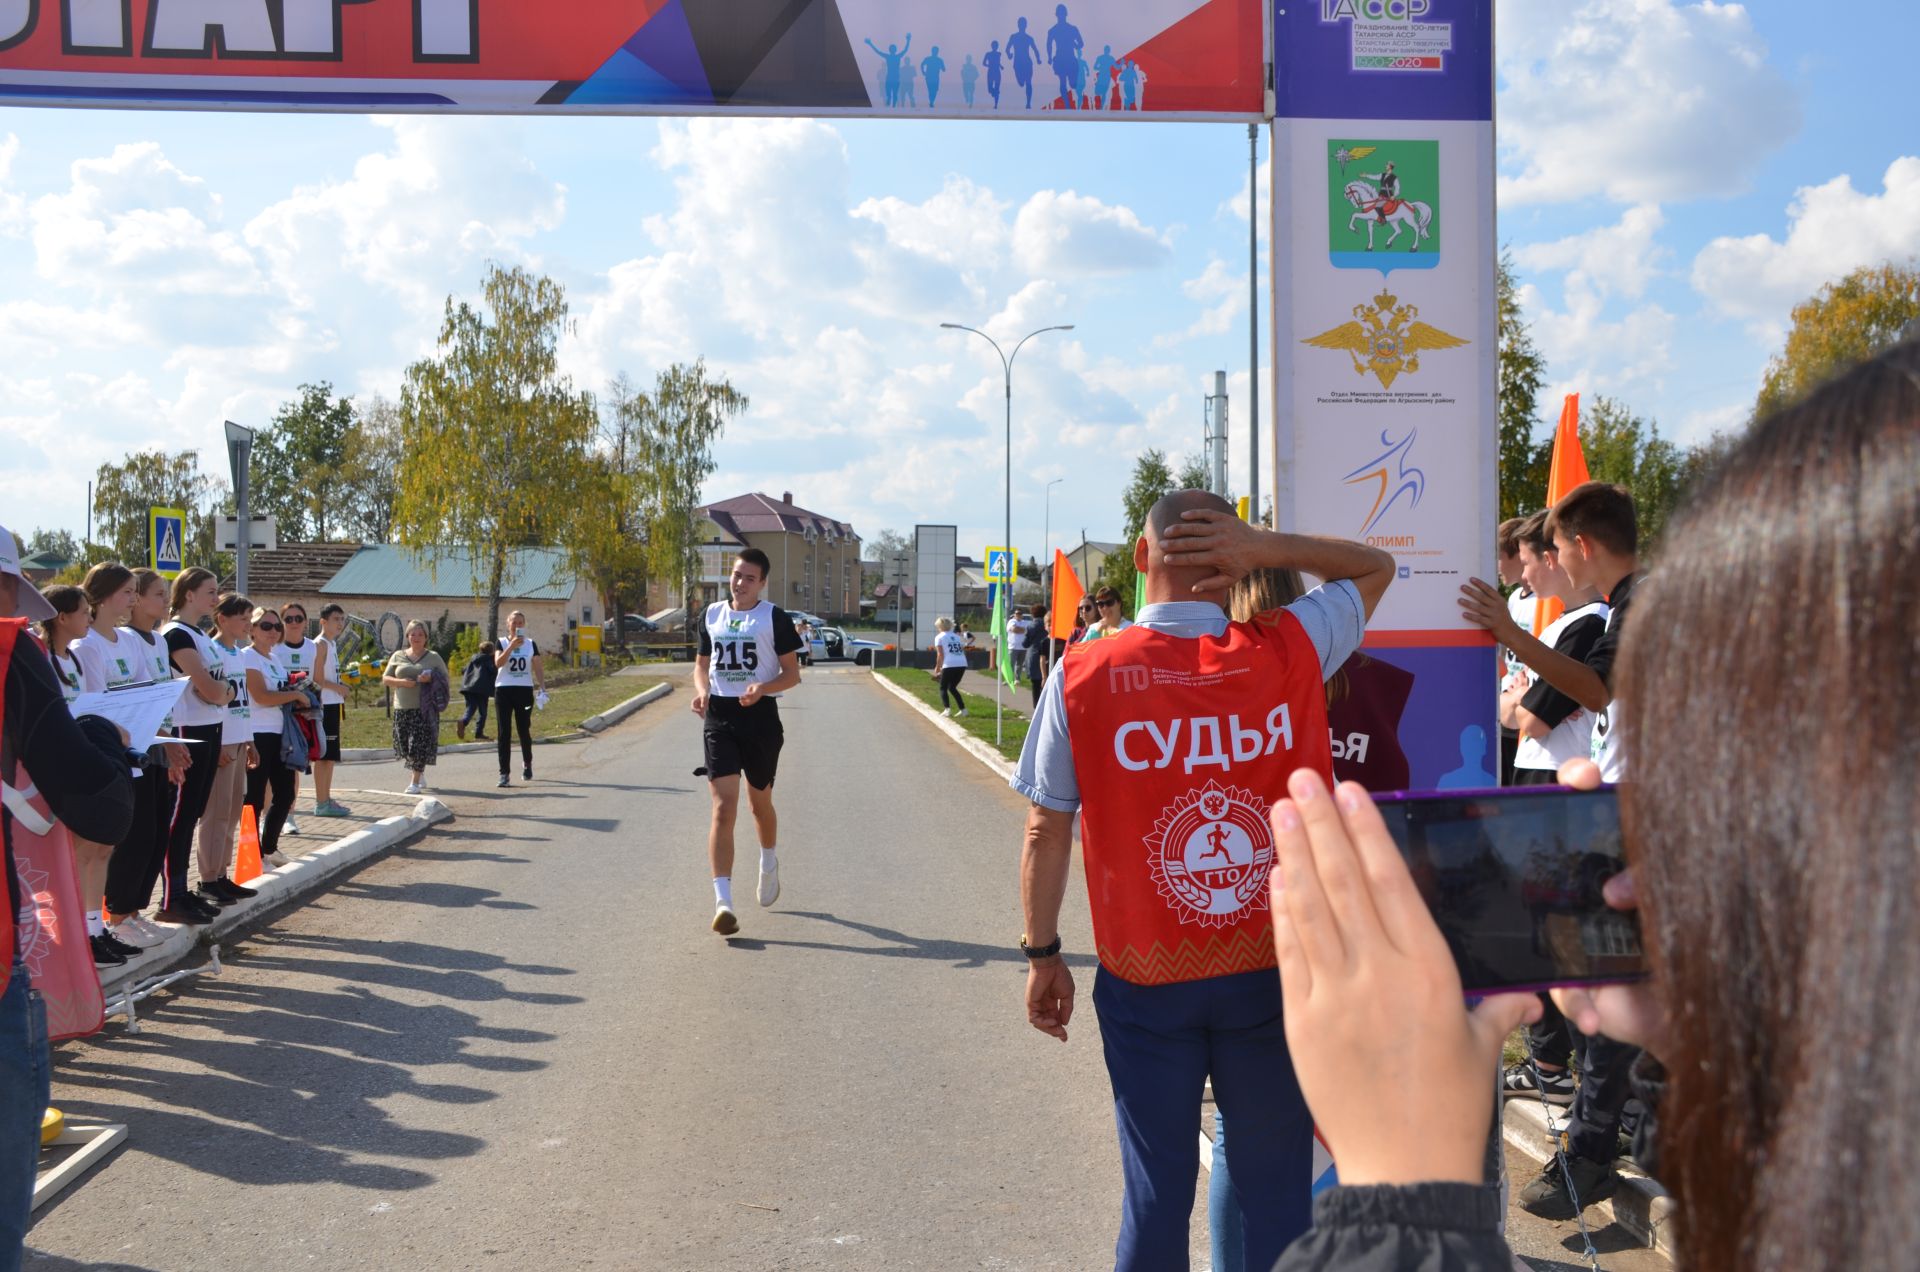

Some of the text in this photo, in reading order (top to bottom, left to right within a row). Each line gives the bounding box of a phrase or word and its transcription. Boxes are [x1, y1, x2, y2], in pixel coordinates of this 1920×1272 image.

[1366, 536, 1415, 547] ОЛИМП
[509, 657, 527, 672] 20
[714, 641, 758, 671] 215
[1114, 703, 1293, 775] СУДЬЯ
[1205, 868, 1240, 886] ГТО
